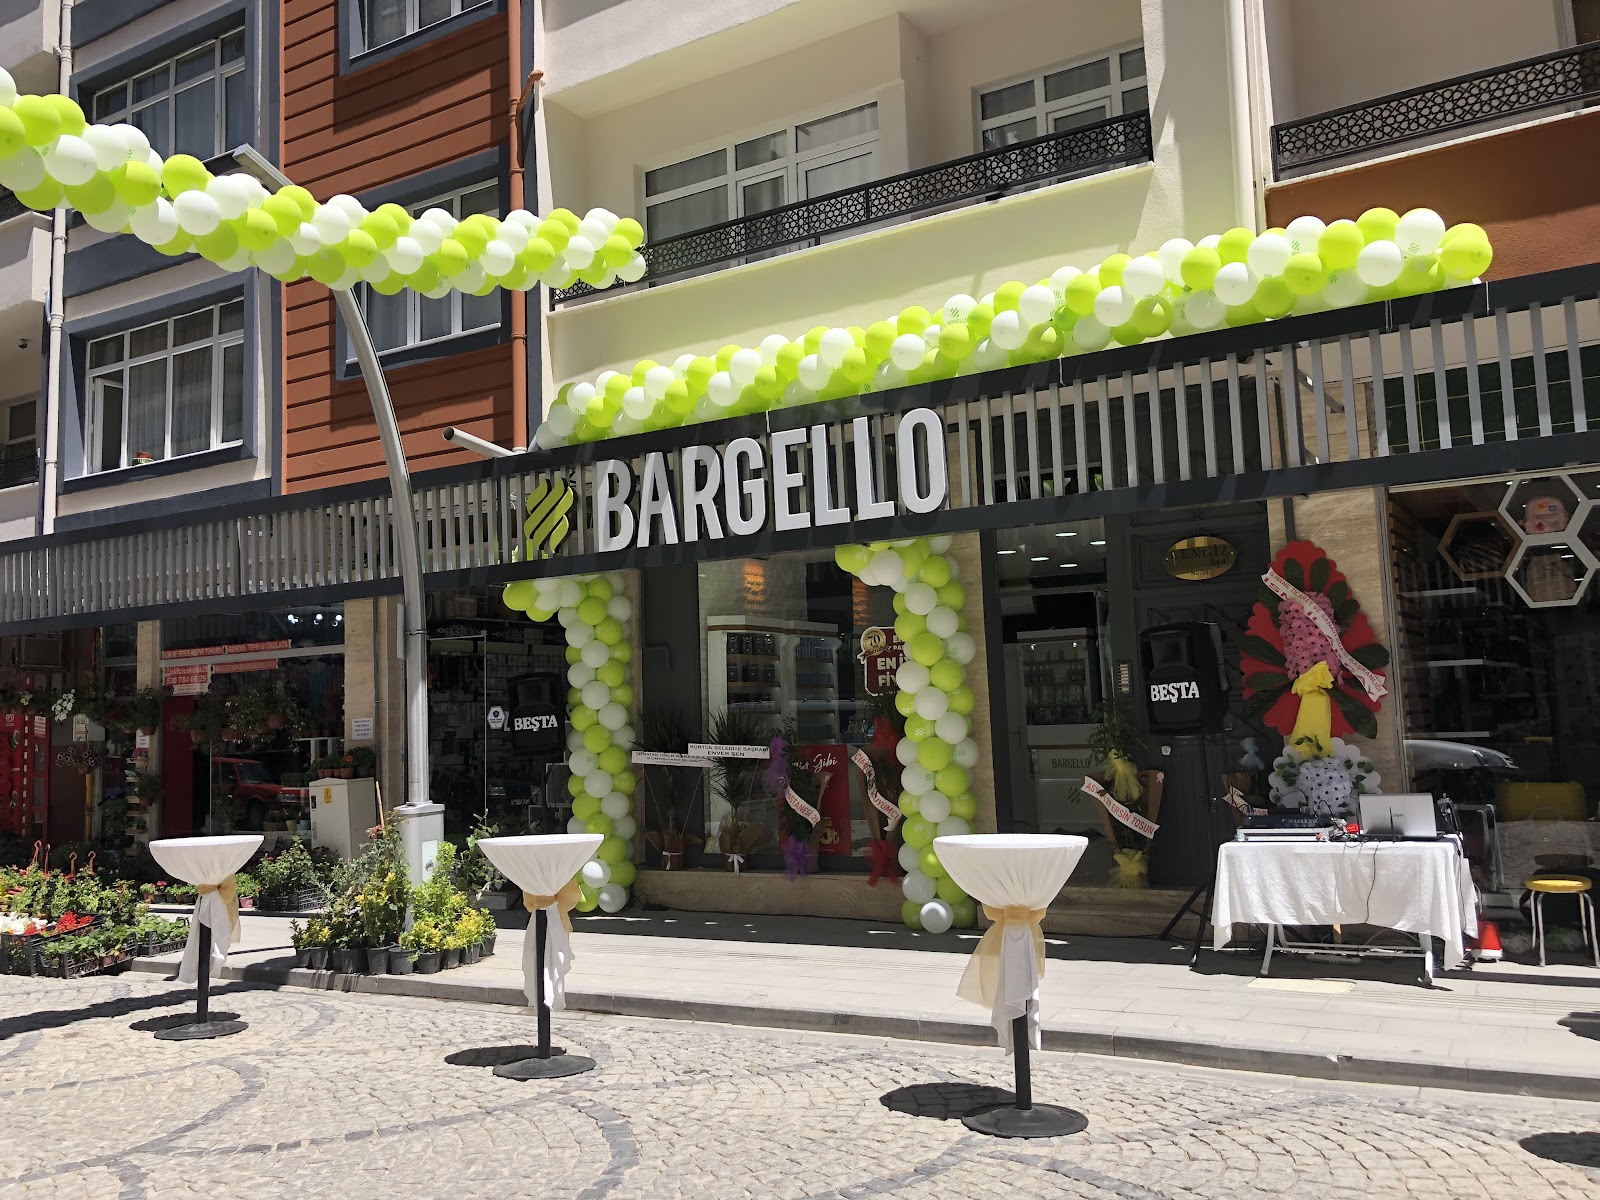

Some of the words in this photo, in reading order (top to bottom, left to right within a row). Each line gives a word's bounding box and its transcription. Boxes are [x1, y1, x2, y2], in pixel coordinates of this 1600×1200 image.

[596, 407, 948, 552] BARGELLO
[1313, 605, 1322, 614] VE
[867, 634, 881, 646] 70
[877, 657, 897, 671] EN
[198, 674, 207, 682] 29
[1150, 681, 1200, 703] BEŞTA
[514, 714, 559, 731] BEŞTA
[1052, 758, 1090, 769] BARGELLO
[1110, 803, 1132, 822] ERSİN
[1130, 816, 1155, 835] TOSUN
